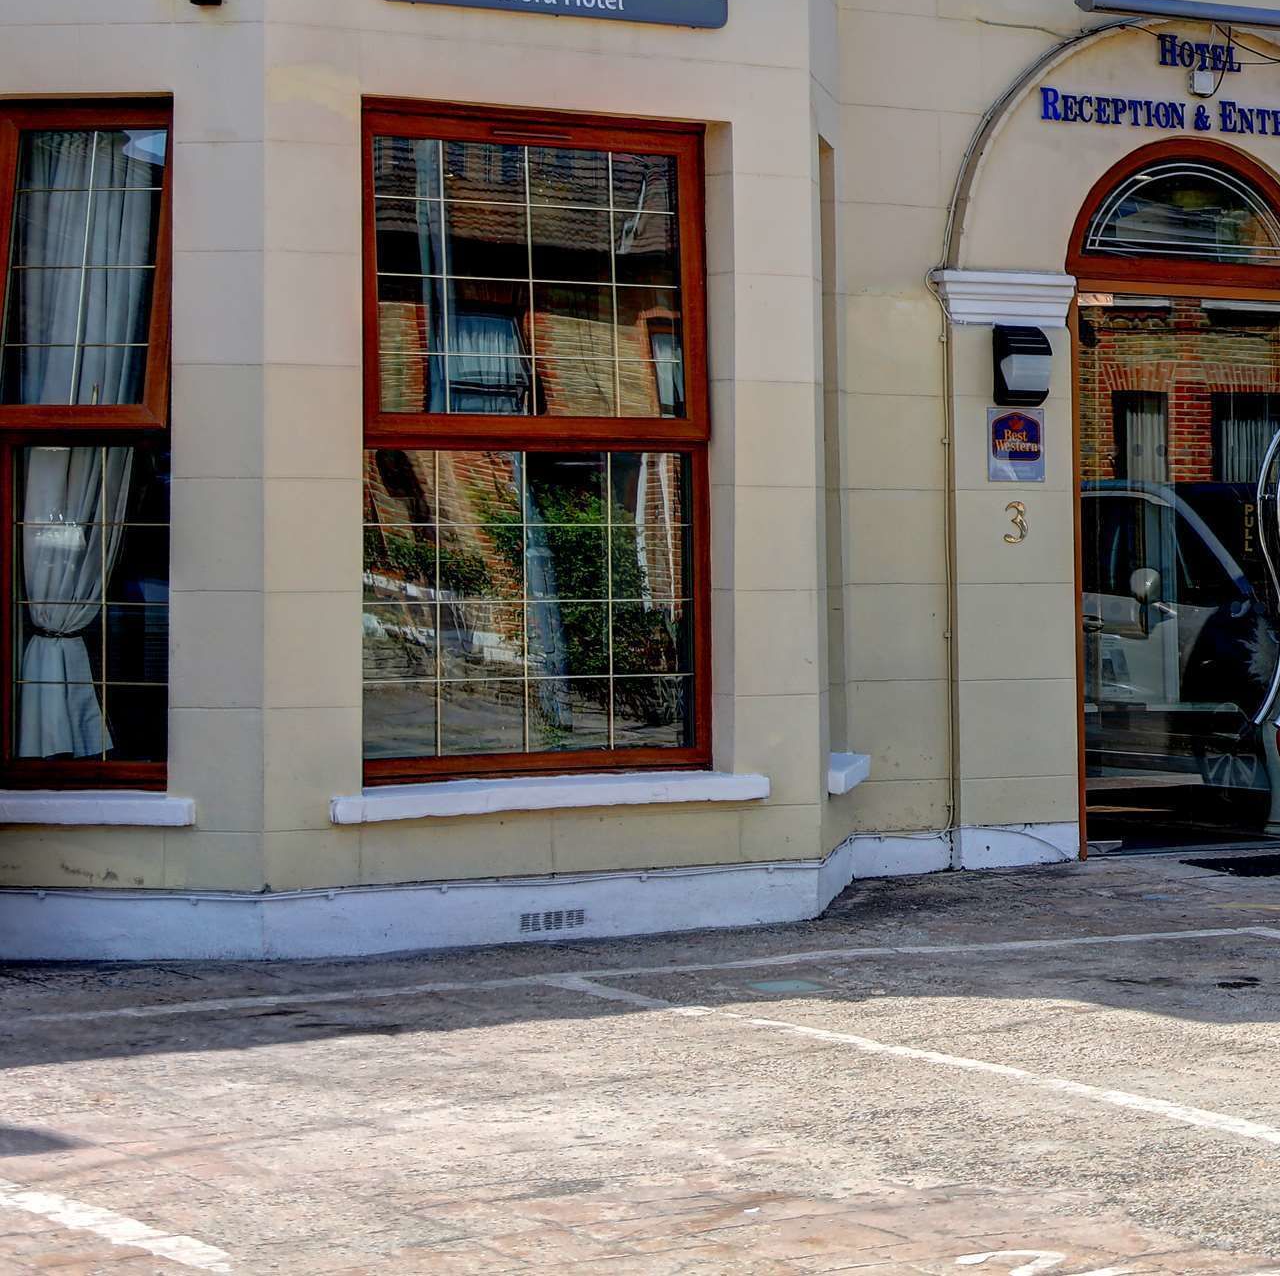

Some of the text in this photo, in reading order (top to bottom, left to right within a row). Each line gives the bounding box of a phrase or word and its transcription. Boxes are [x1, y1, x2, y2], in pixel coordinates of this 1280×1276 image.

[1193, 105, 1210, 131] &
[995, 439, 1039, 452] Western
[1003, 429, 1028, 442] Best
[1003, 500, 1029, 544] 3
[1245, 504, 1254, 551] PULL
